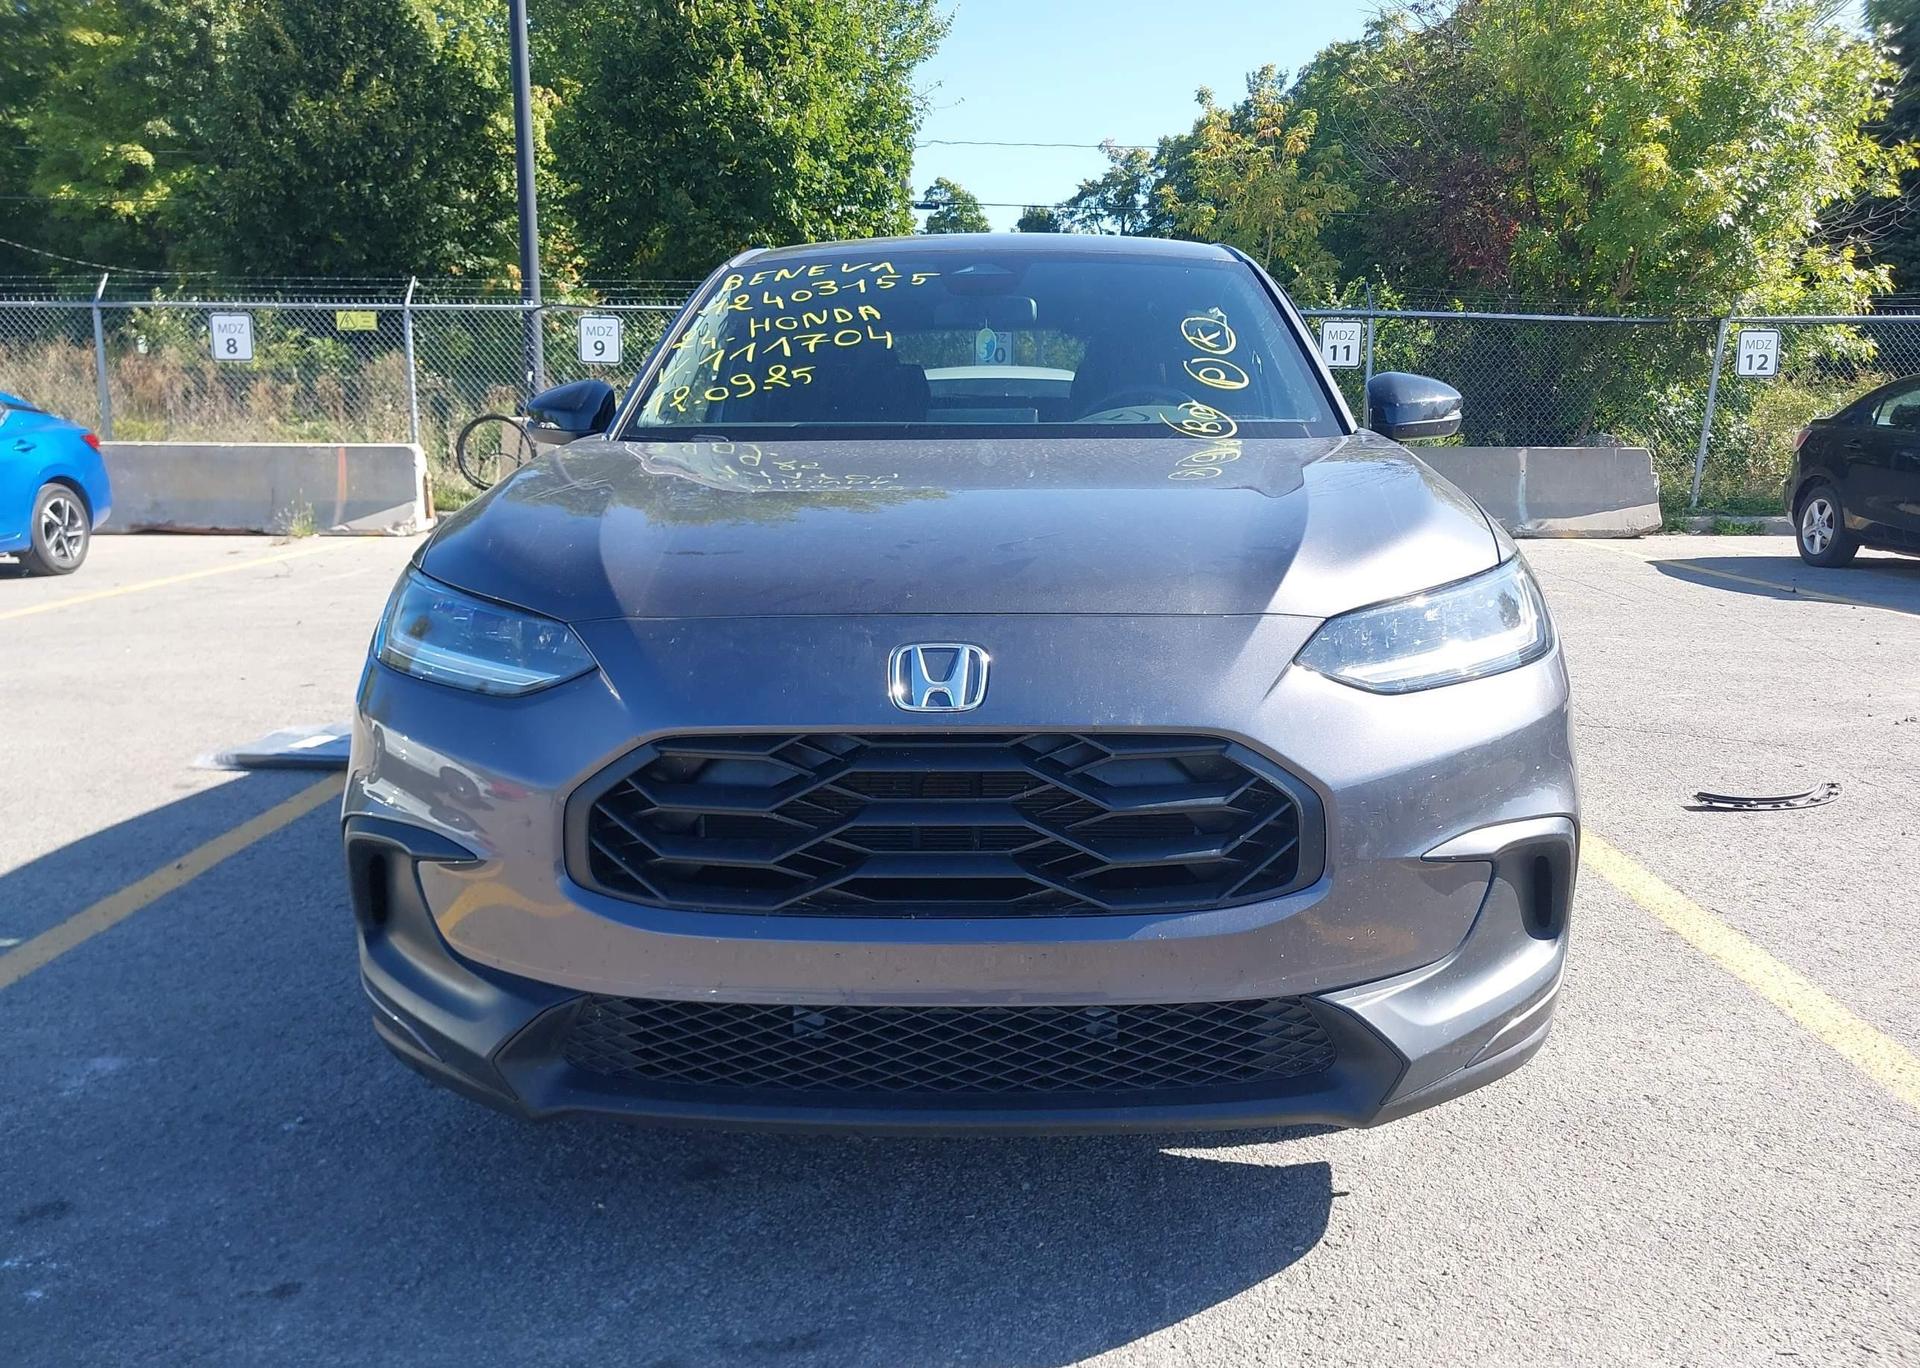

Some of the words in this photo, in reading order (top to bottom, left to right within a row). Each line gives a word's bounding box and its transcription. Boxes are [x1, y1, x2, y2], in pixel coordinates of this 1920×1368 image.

[720, 262, 895, 294] BENEVA
[217, 323, 245, 334] MDZ
[586, 326, 614, 337] MDZ
[1328, 330, 1356, 341] MDZ
[226, 338, 238, 354] 8
[593, 340, 606, 357] 9
[1329, 344, 1351, 361] 11
[1744, 339, 1772, 350] MDZ
[1745, 353, 1769, 371] 12
